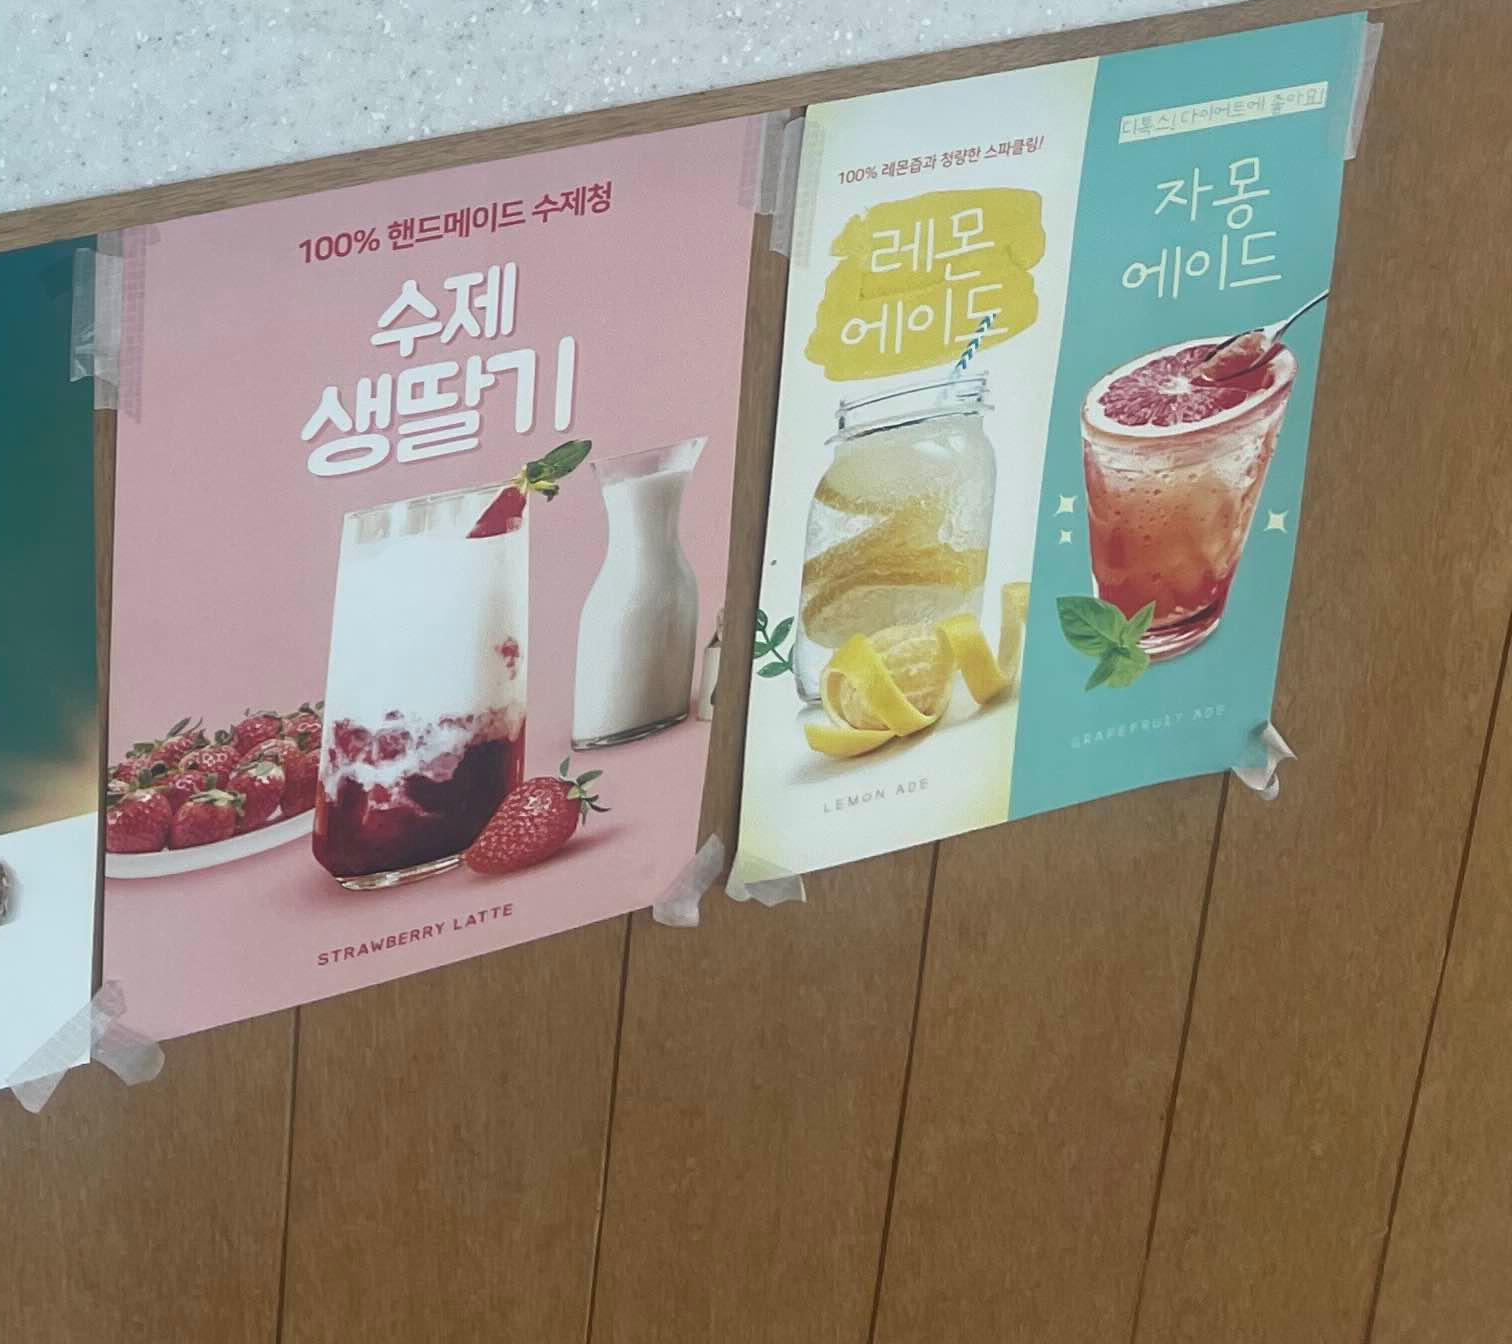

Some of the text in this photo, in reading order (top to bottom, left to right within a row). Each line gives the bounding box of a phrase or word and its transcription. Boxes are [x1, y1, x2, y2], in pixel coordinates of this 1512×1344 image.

[838, 164, 878, 184] 100%
[881, 154, 937, 179] 레몬즙과
[940, 146, 982, 168] 청량한
[1154, 157, 1271, 230] 자몽
[299, 181, 612, 263] 100% 핸드메이드 수제청
[870, 207, 995, 281] 레몬
[1121, 231, 1283, 300] 에이드
[370, 262, 517, 358] 수제
[839, 283, 1009, 355] 에이드
[300, 335, 576, 478] 생딸기
[823, 777, 929, 814] LEMON ADE
[317, 903, 513, 966] STRAWBERRY LATTE
